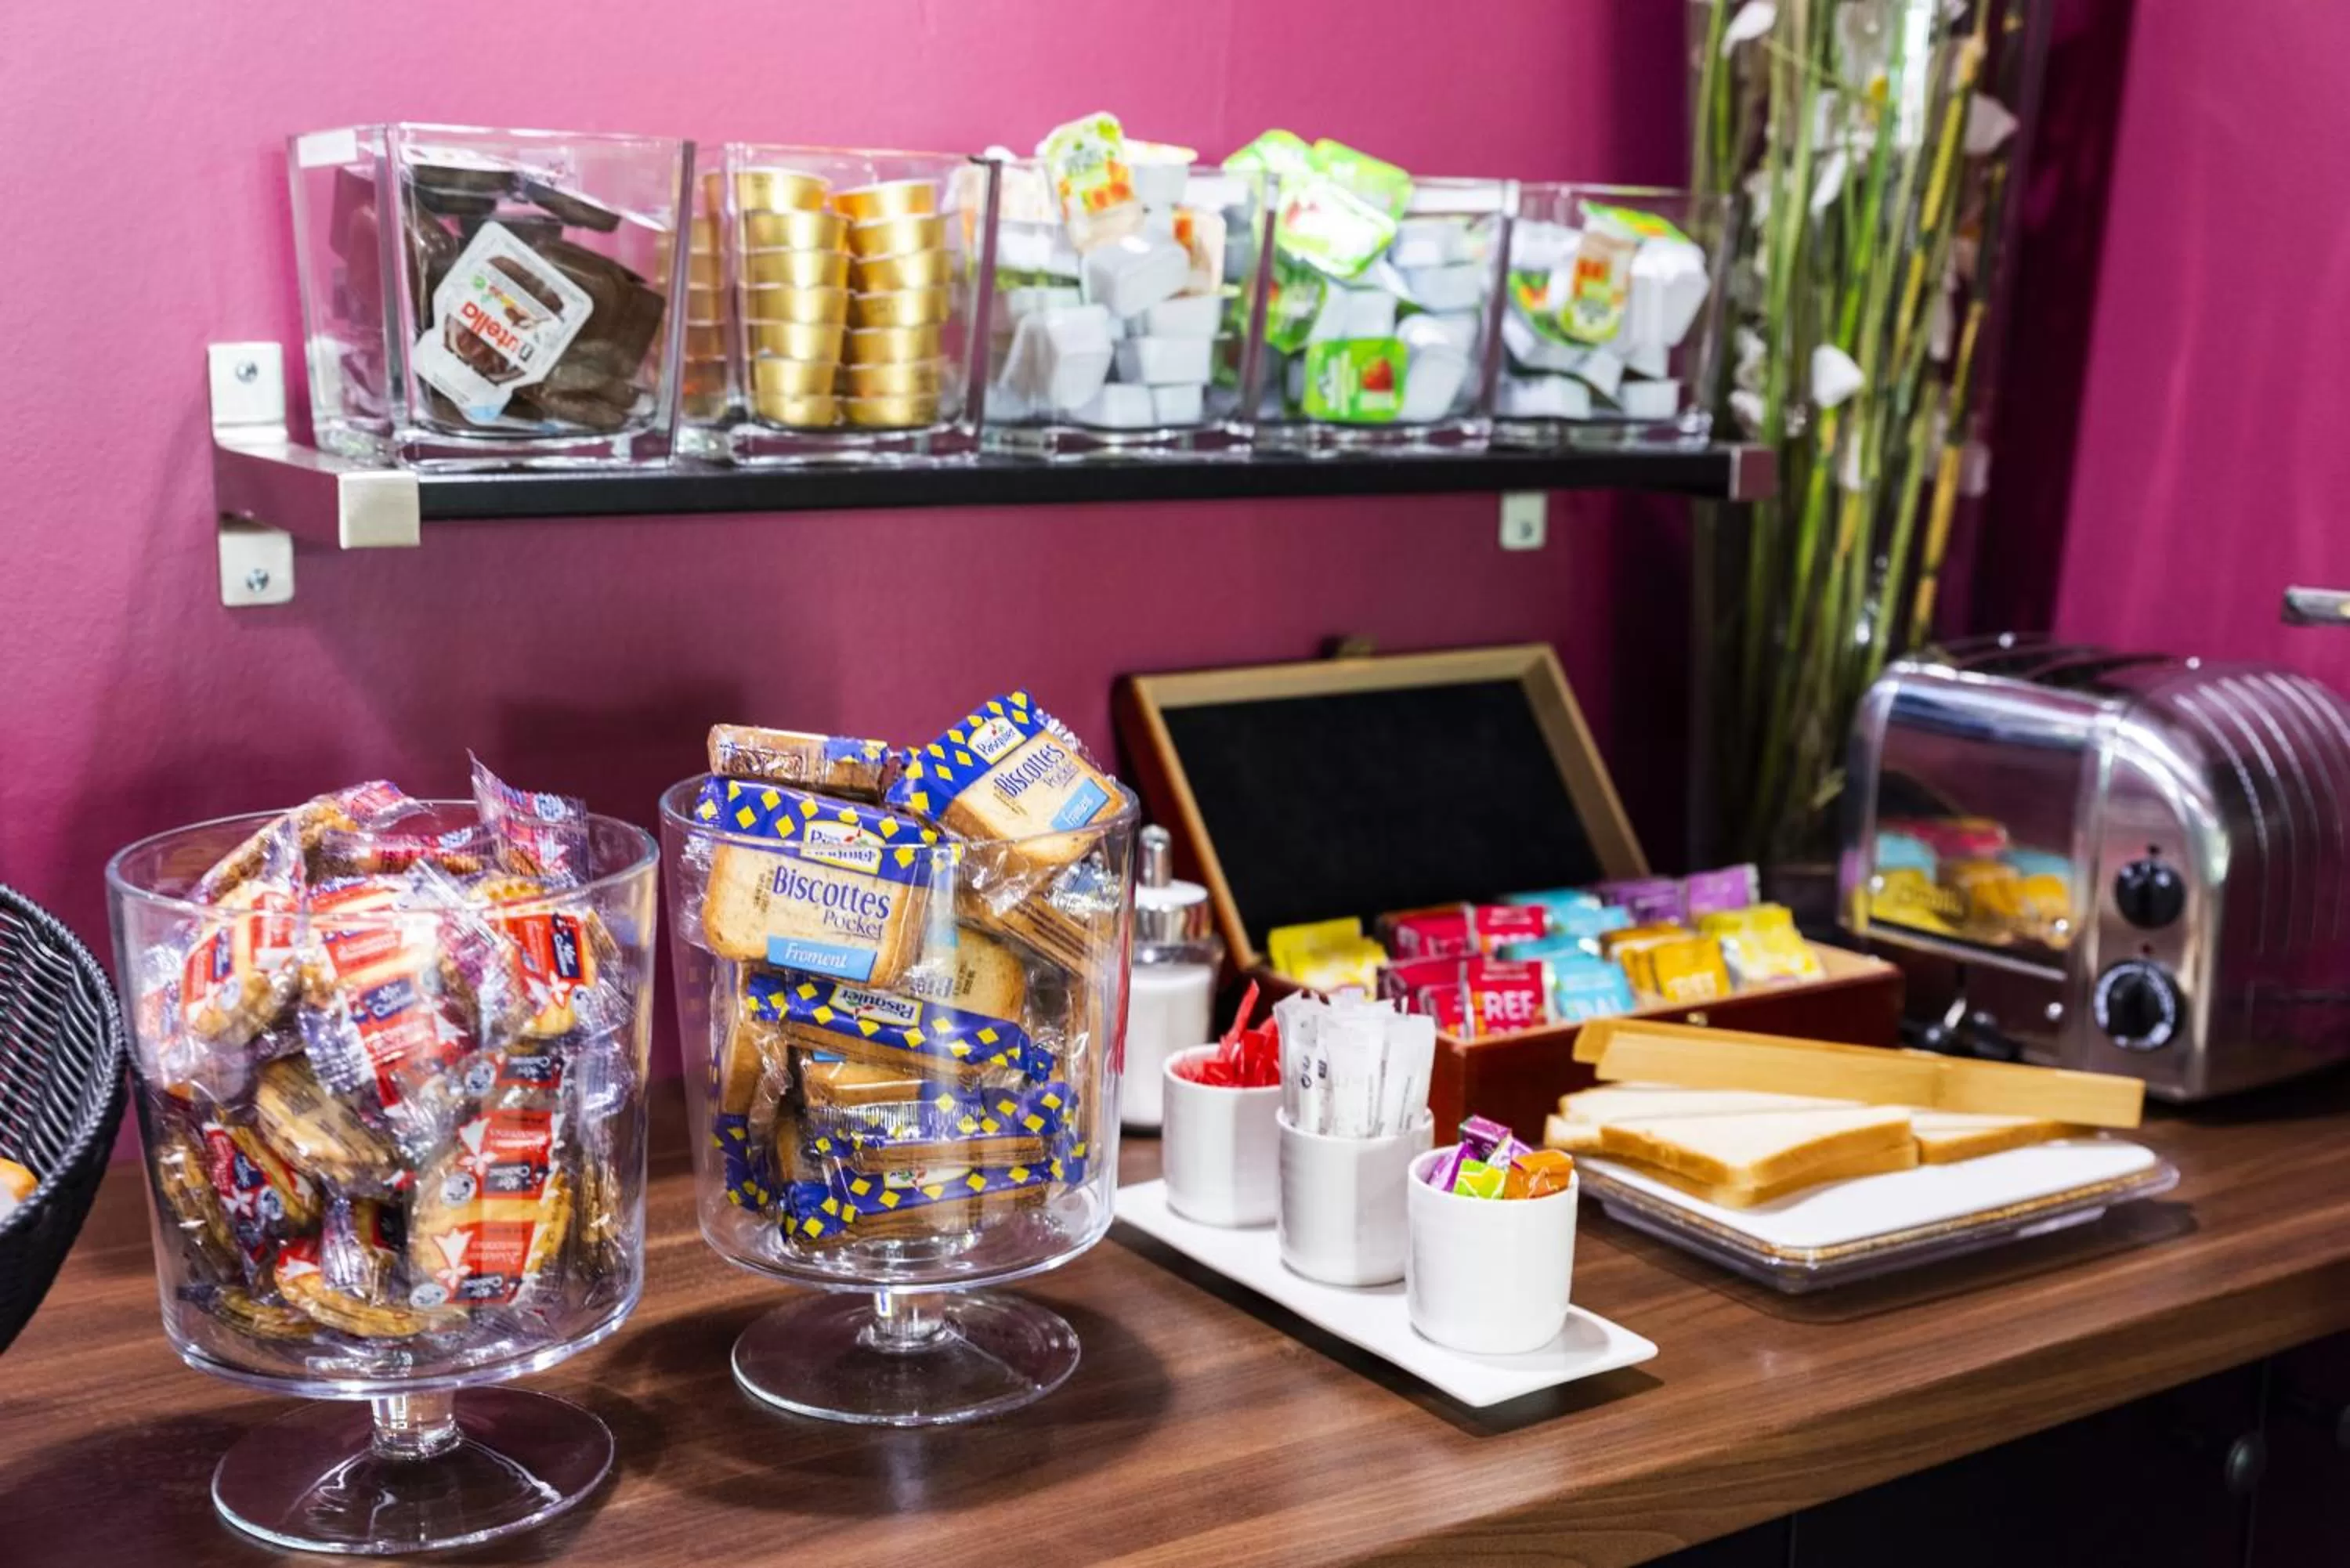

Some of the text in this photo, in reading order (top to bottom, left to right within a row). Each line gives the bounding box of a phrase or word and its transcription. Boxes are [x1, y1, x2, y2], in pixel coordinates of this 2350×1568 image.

[461, 301, 535, 362] nutella
[993, 743, 1065, 798] Biscottes
[773, 865, 891, 919] Biscottes
[823, 909, 884, 940] Pocket
[785, 942, 849, 968] Froment
[840, 988, 916, 1019] Pasquier
